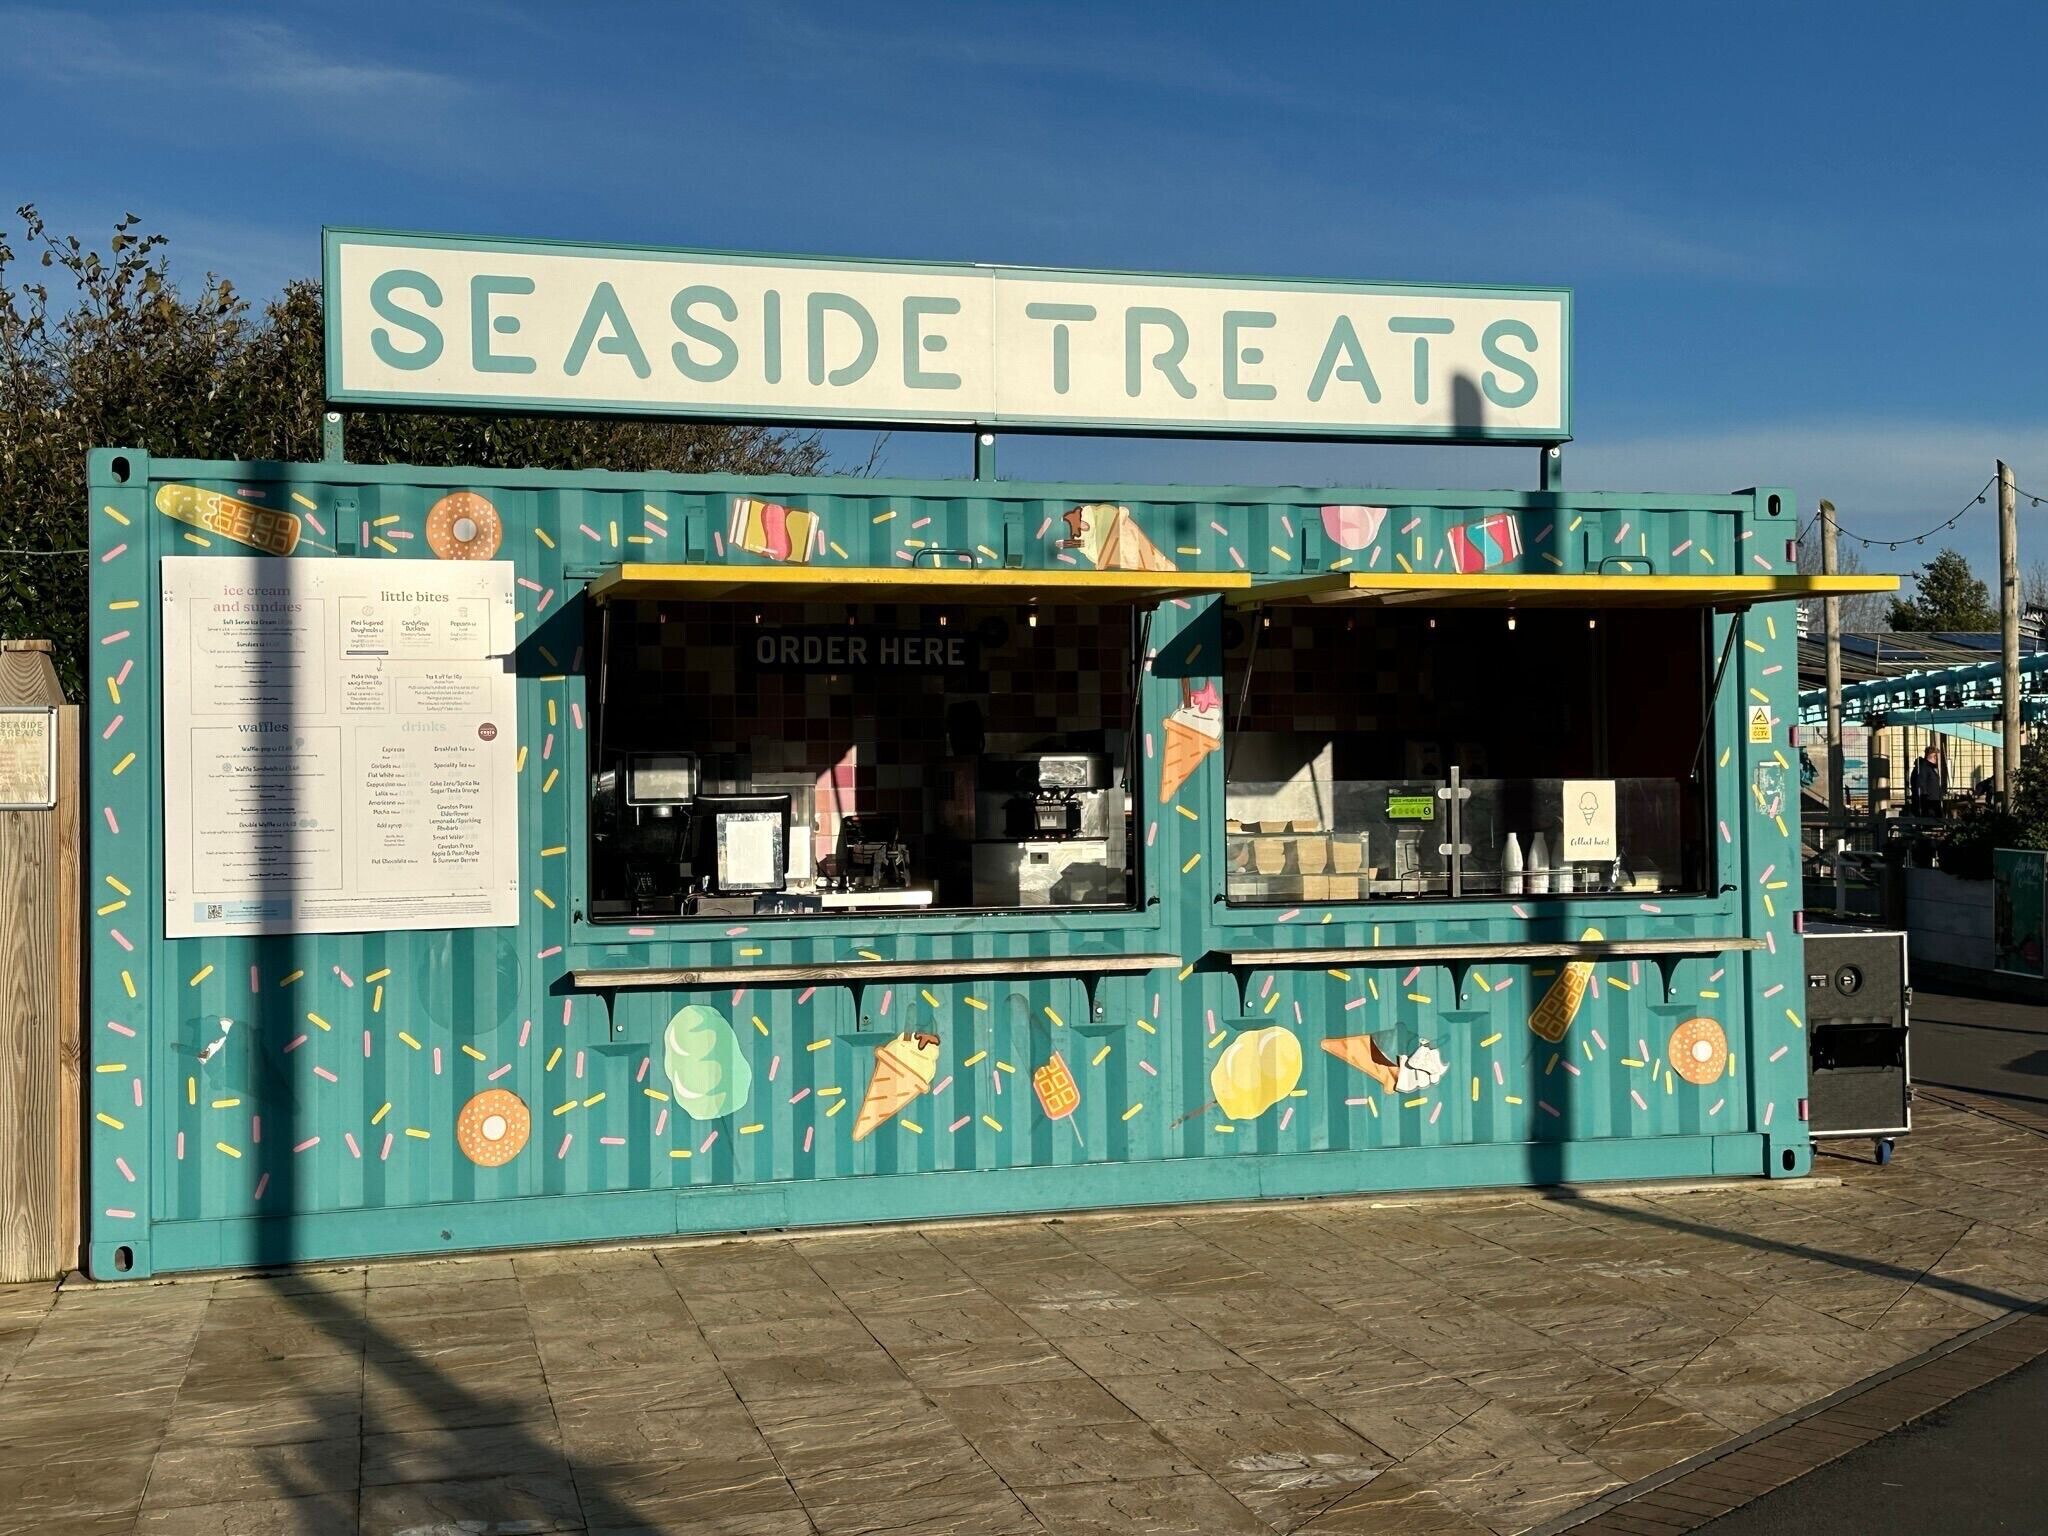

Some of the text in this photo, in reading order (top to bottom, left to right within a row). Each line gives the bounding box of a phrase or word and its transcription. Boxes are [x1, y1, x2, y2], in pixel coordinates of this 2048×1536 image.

[370, 269, 1539, 409] SEASIDE TREATS
[224, 585, 291, 596] ice cream
[381, 591, 450, 602] little bites
[213, 601, 302, 612] and sundaes
[756, 636, 966, 666] ORDER HERE
[0, 721, 44, 729] SEASIDE
[238, 722, 289, 732] waffles
[402, 721, 447, 732] drinks
